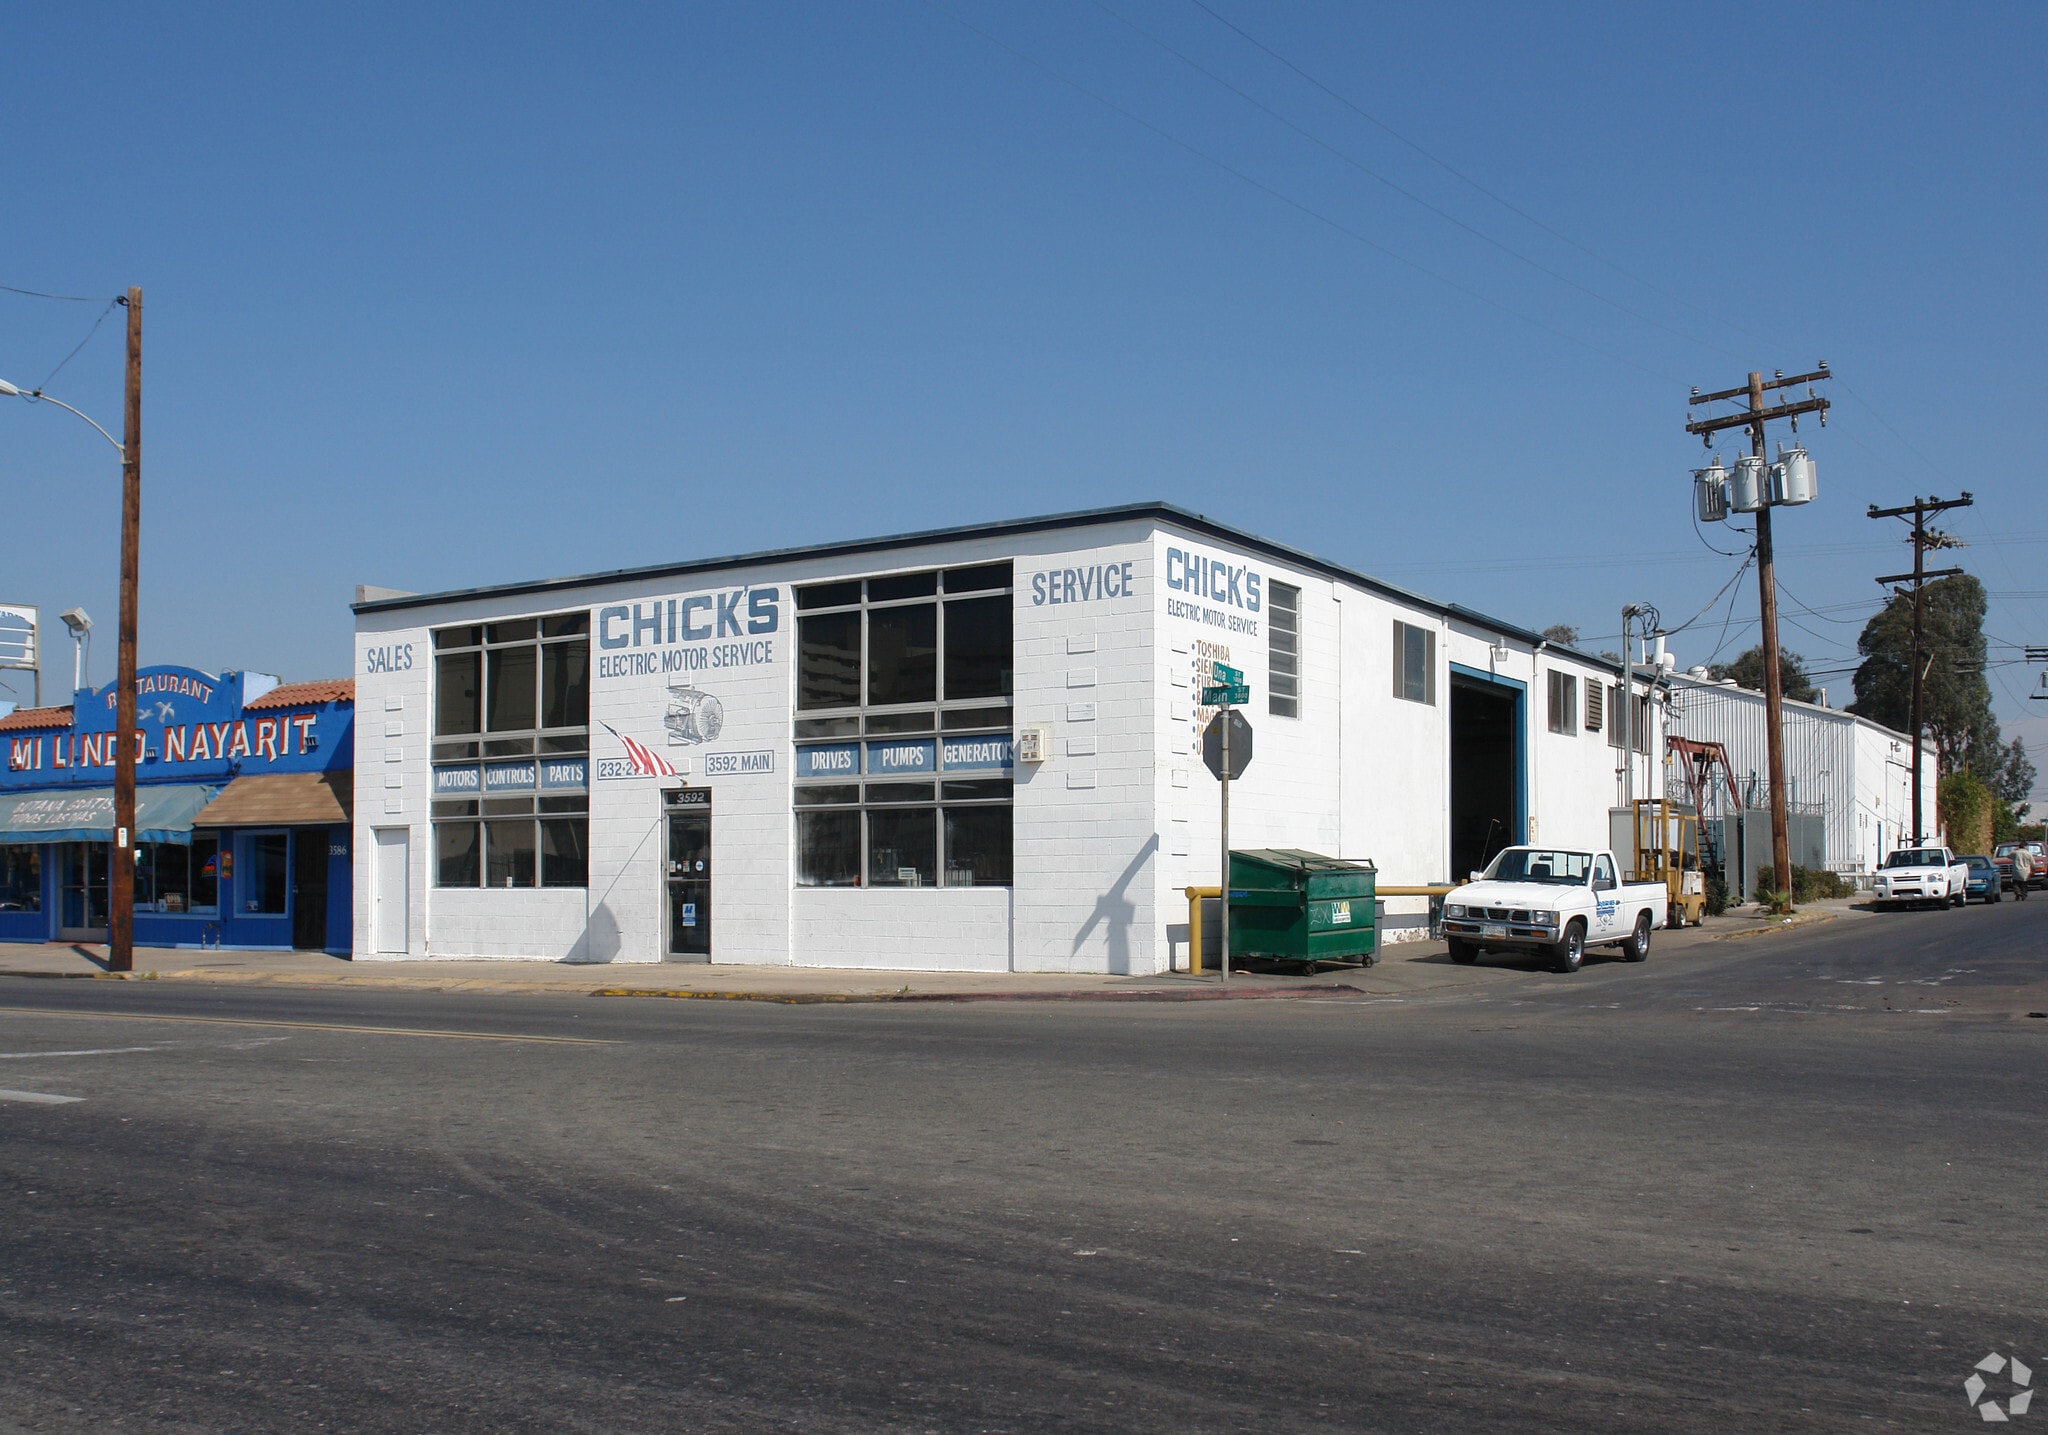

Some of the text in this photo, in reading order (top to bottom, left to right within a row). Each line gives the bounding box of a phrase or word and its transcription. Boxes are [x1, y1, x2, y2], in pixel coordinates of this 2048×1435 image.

[1032, 562, 1132, 606] SERVICE
[1167, 547, 1260, 612] CHICK'S
[600, 586, 779, 650] CHICK'S
[1167, 598, 1257, 636] ELECTRIC MOTOR SERVICE
[367, 643, 412, 673] SALES
[600, 641, 772, 678] ELECTRIC MOTOR SERVICE
[1196, 640, 1230, 662] TOSHIBA
[1214, 665, 1226, 681] Una
[1204, 690, 1228, 702] Main
[11, 738, 41, 770] MI
[164, 714, 317, 763] NAYARIT
[708, 754, 770, 772] 3592 MAIN
[811, 750, 852, 770] DRIVES
[882, 746, 924, 767] PUMPS
[438, 764, 583, 787] MOTORS CONTROLS PARTS
[677, 792, 705, 803] 3592
